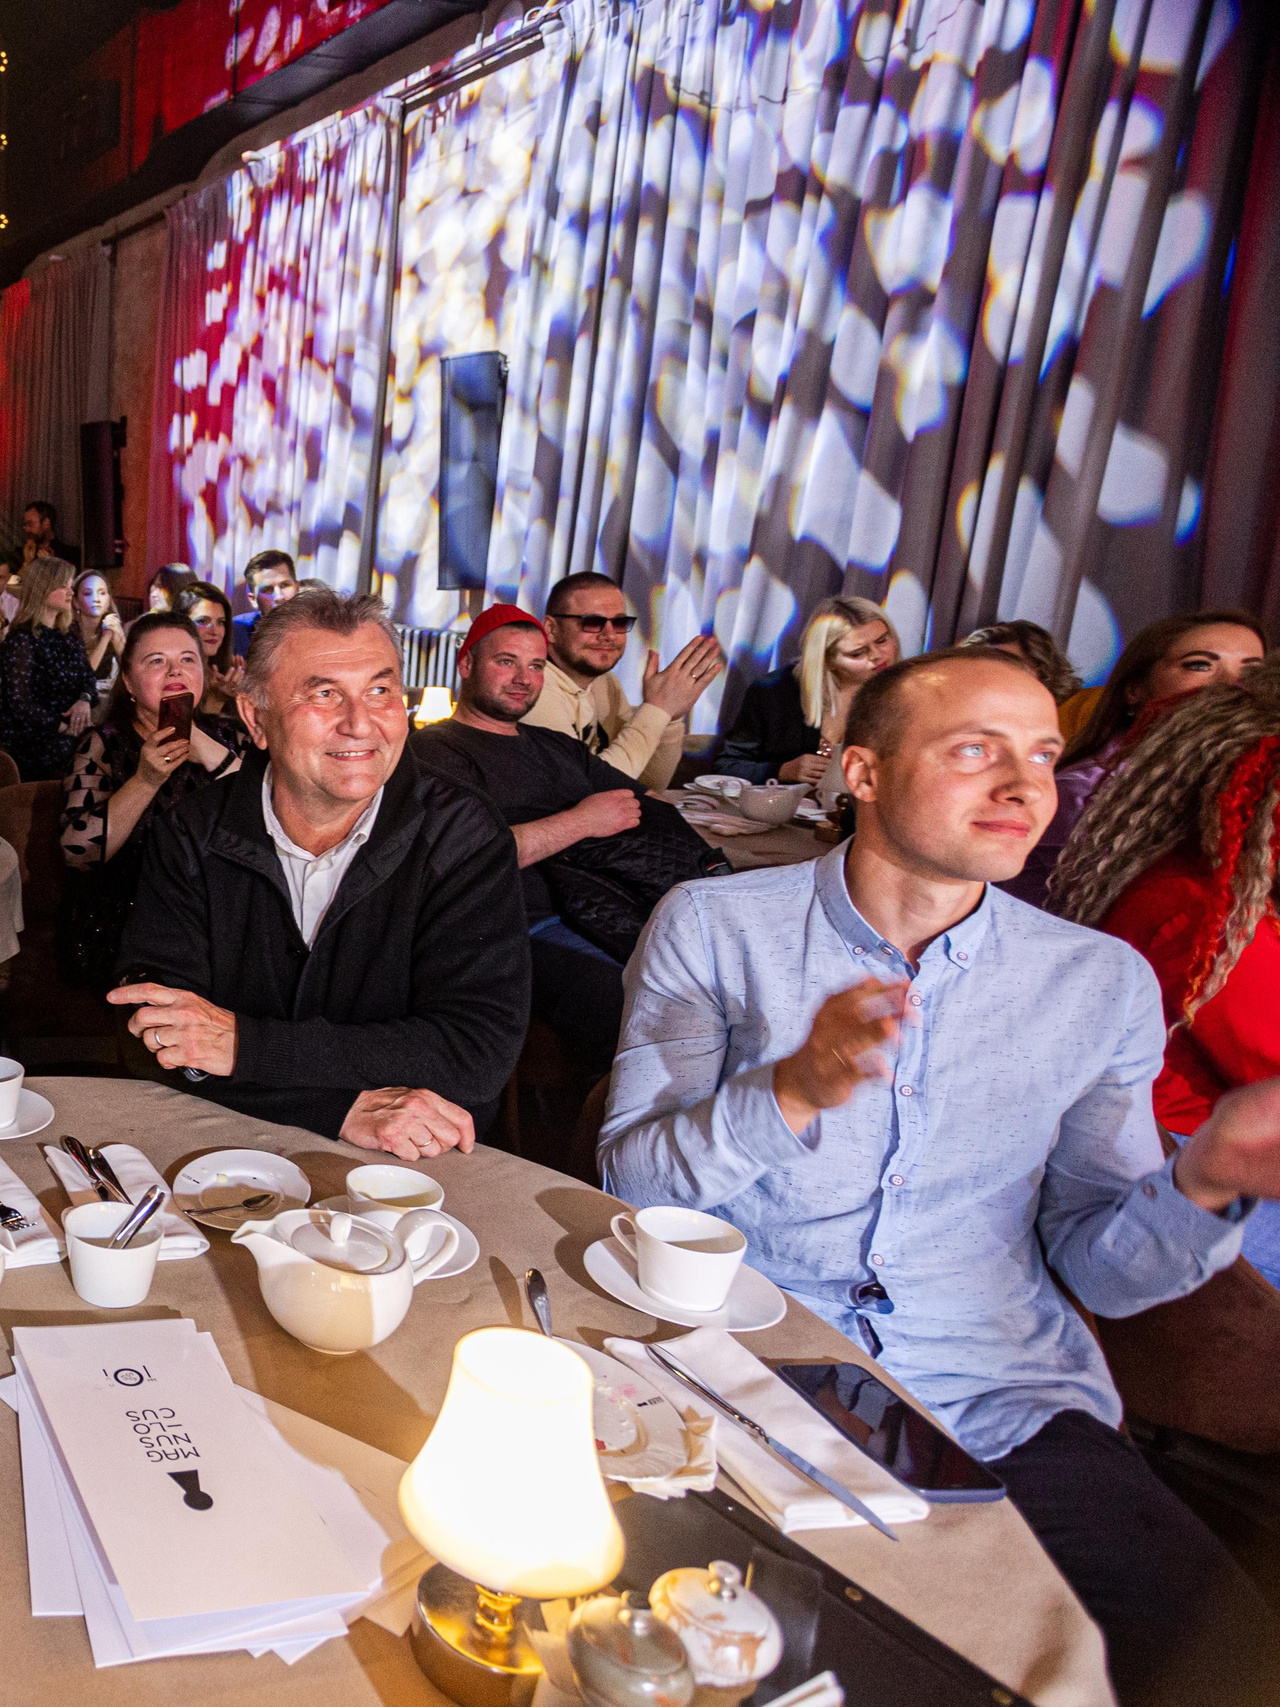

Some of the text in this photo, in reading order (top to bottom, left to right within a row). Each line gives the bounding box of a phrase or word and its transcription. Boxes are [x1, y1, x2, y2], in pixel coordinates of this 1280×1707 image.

[125, 1407, 176, 1422] CUS
[139, 1433, 192, 1449] NUS
[146, 1446, 201, 1463] MAG
